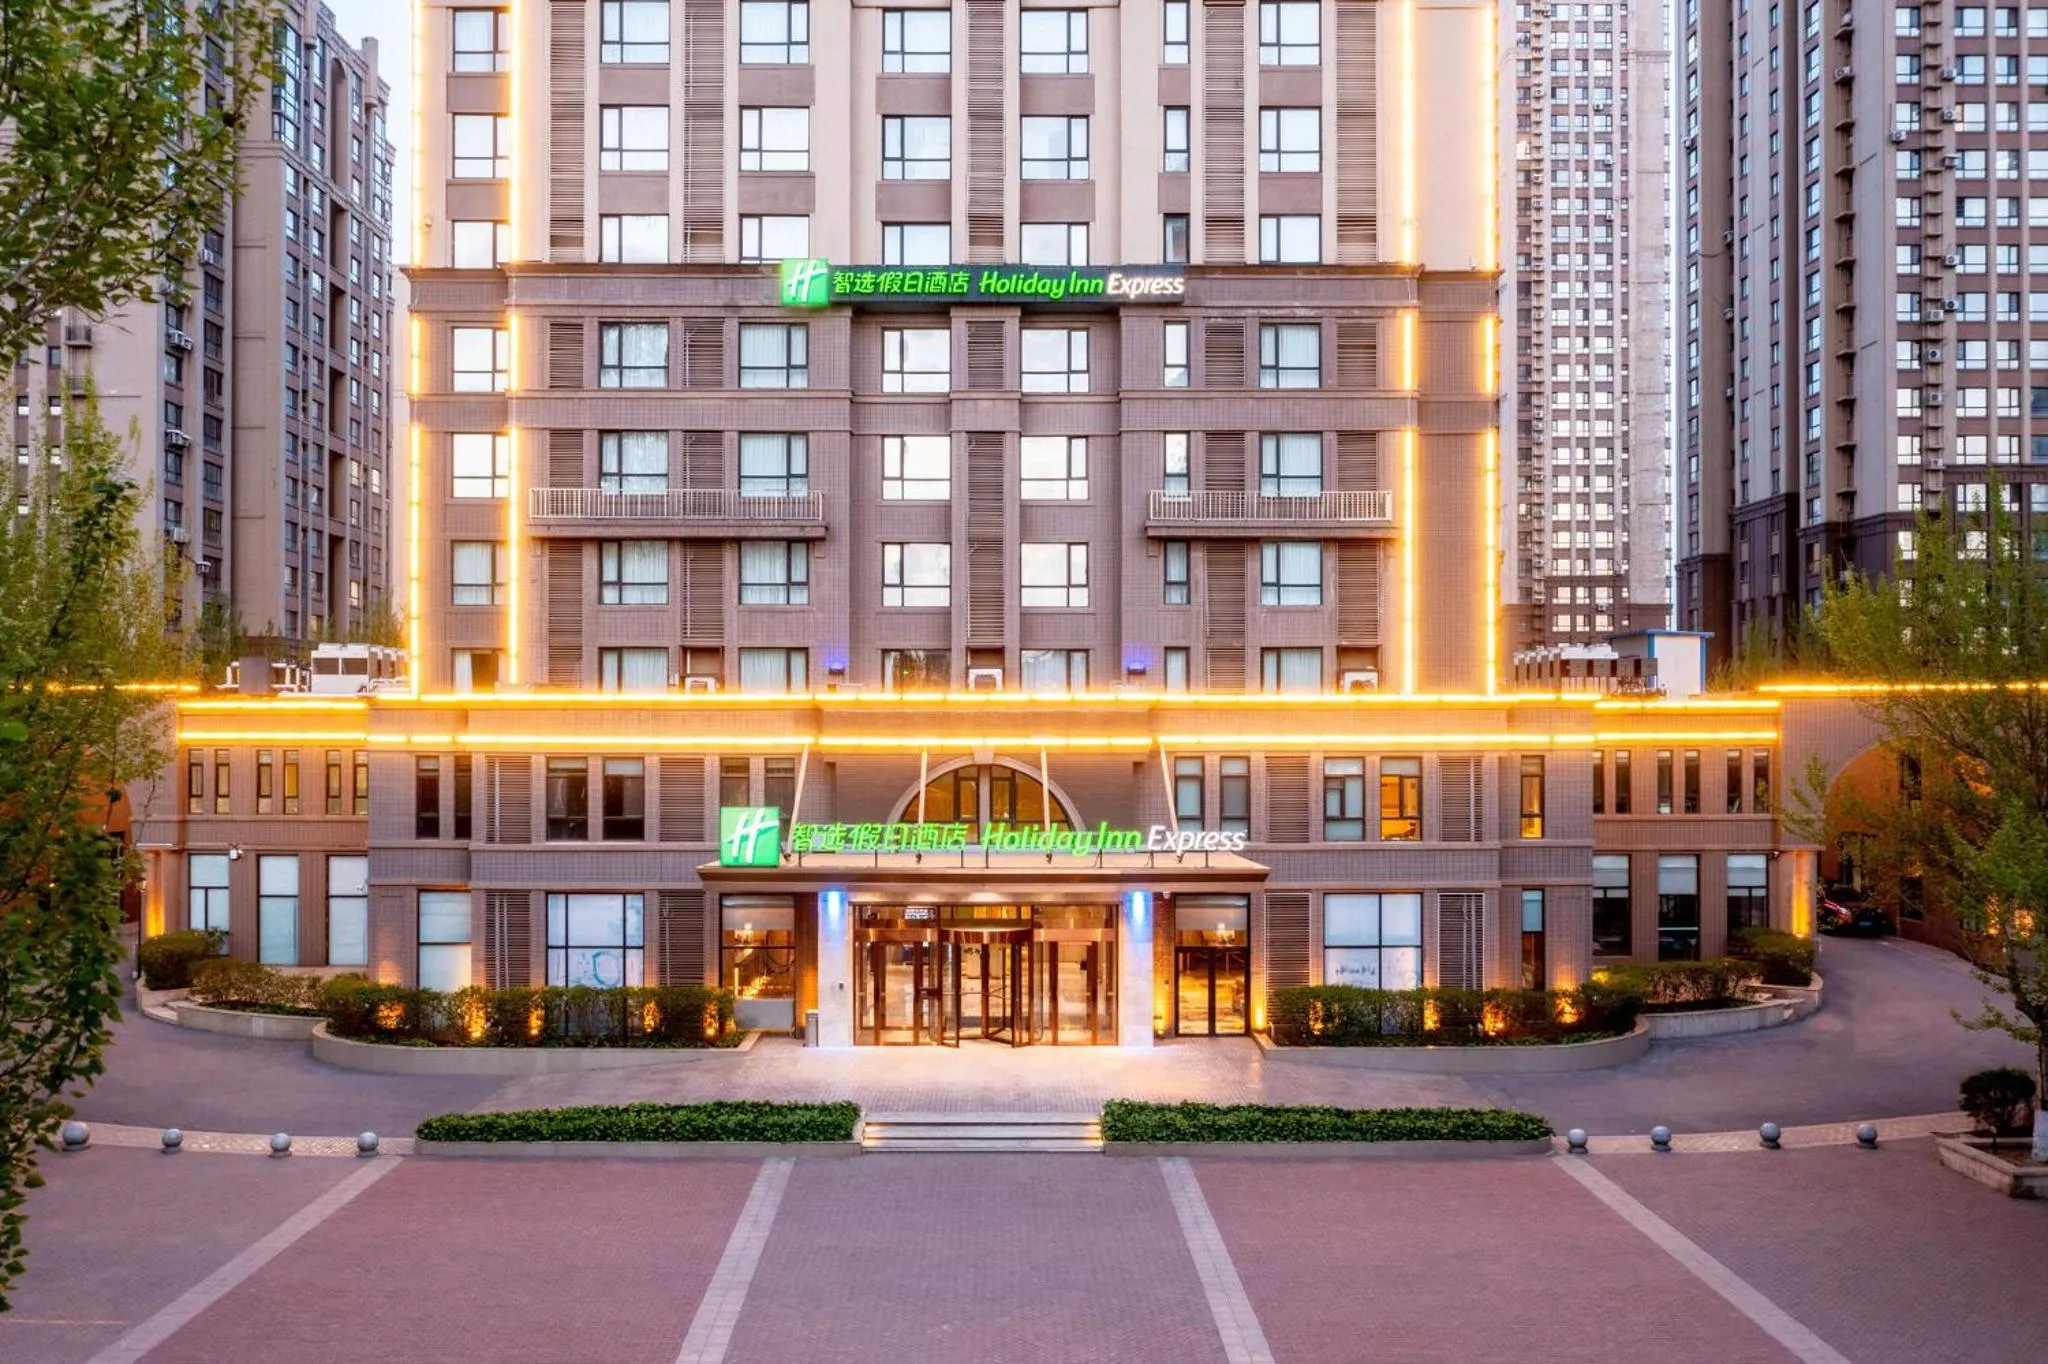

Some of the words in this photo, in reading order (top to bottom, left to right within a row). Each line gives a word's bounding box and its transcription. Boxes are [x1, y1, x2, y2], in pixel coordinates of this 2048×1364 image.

[832, 270, 970, 294] 智选假日酒店
[979, 271, 1065, 299] Holiday
[1069, 271, 1105, 294] Inn
[1106, 273, 1185, 299] Express
[793, 821, 969, 851] 智选假日酒店
[980, 821, 1093, 857] Holiday
[1096, 821, 1142, 850] Inn
[1147, 825, 1246, 856] Express
